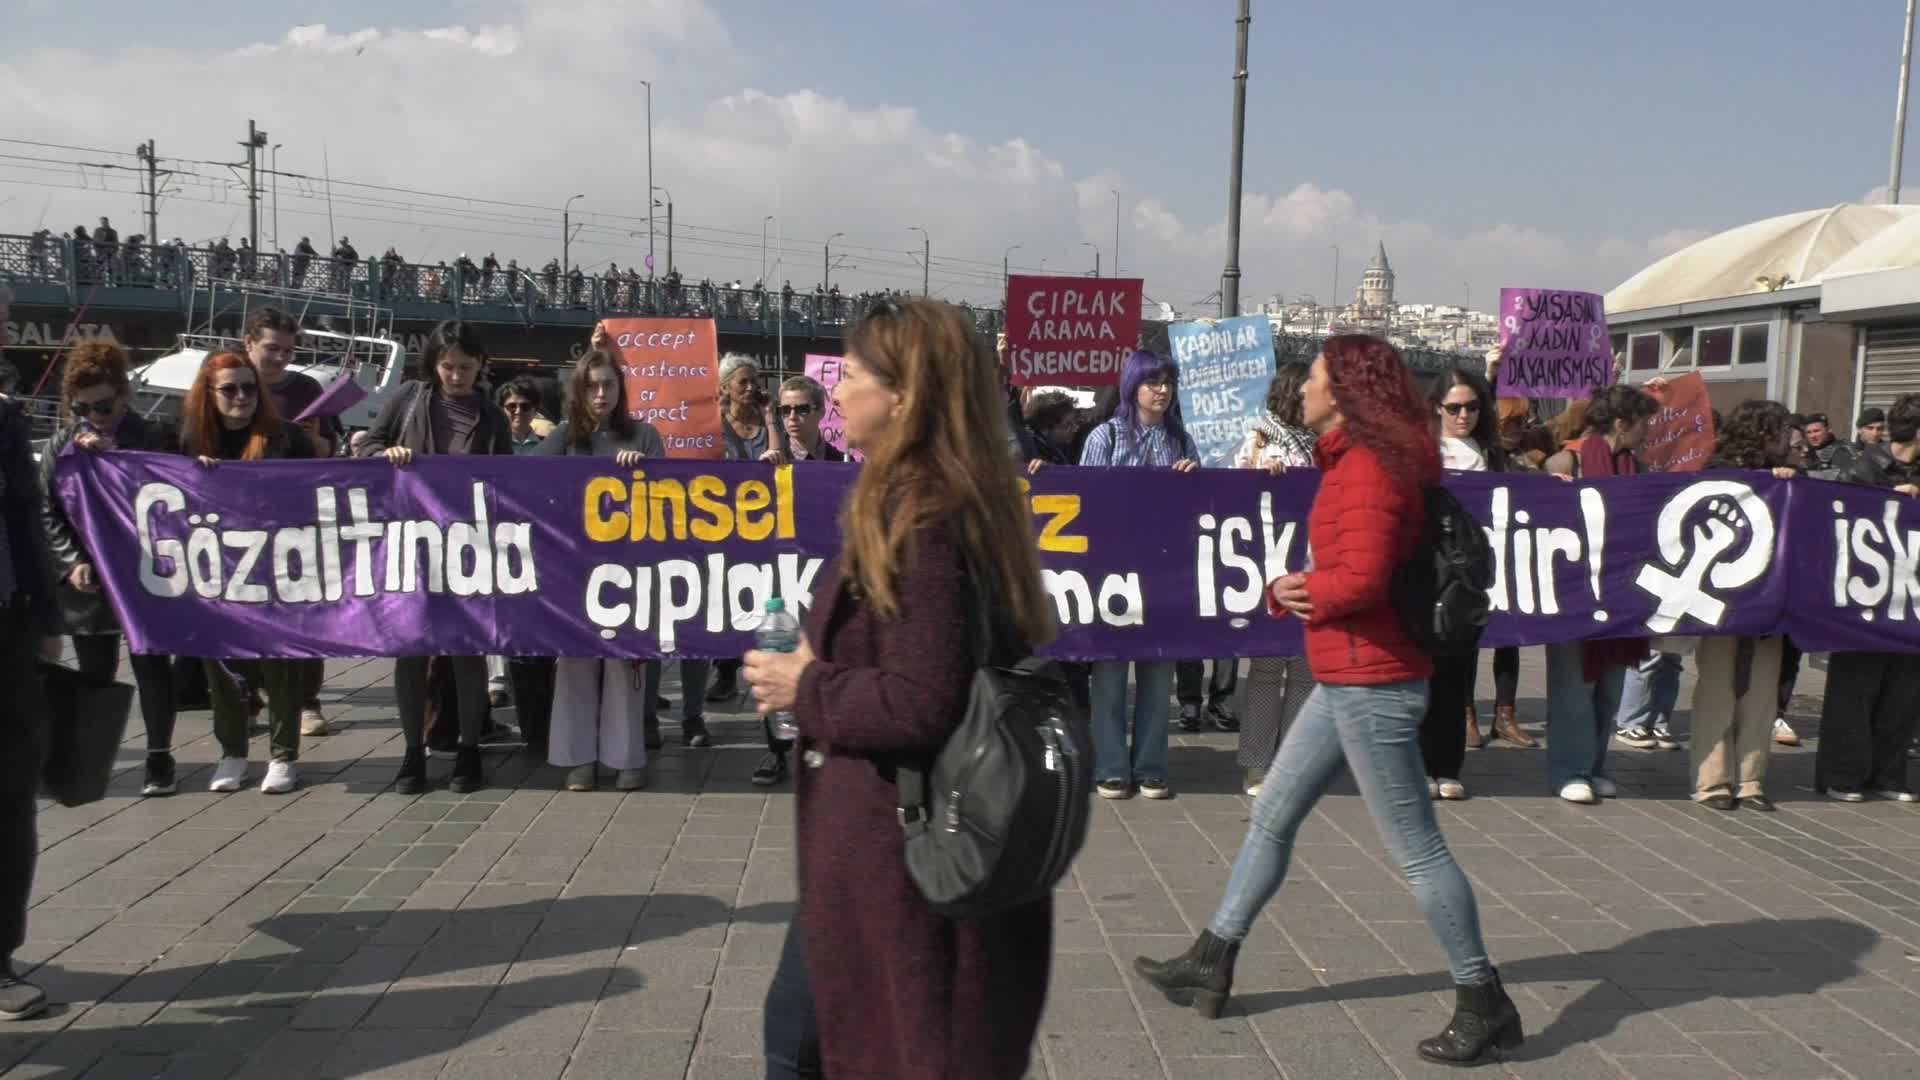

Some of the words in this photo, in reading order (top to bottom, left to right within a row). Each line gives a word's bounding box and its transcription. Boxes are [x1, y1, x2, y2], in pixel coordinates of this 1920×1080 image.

[1027, 289, 1125, 319] ÇIPLAK
[1521, 293, 1595, 323] YAŞASIN
[616, 330, 697, 351] accept
[1028, 320, 1116, 340] ARAMA
[1175, 327, 1258, 363] KADINLAR
[1527, 325, 1580, 351] KADIN
[1507, 355, 1608, 388] DAYANIŞMASI
[639, 389, 656, 401] or
[1192, 384, 1244, 416] POLİS
[584, 464, 796, 542] cinsel
[135, 481, 538, 602] Gözaltında
[586, 553, 824, 652] çıplak
